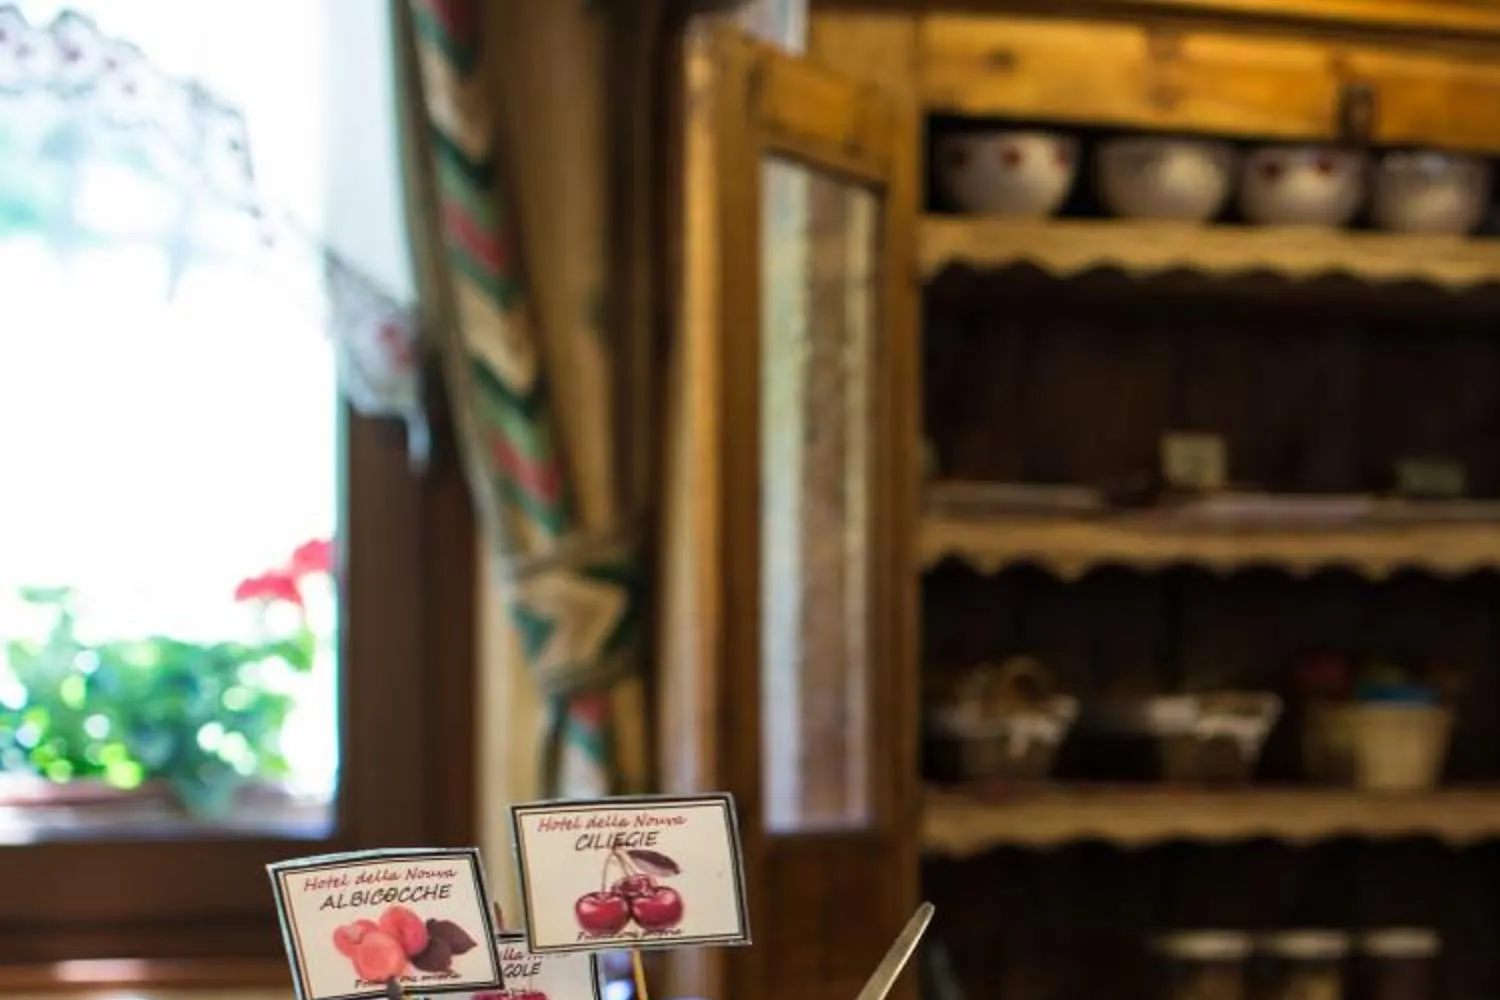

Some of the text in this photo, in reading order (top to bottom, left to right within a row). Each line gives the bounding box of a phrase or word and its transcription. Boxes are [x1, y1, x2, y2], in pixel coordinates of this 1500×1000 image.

[537, 816, 582, 832] Hotel
[585, 813, 630, 829] della
[574, 830, 660, 851] CILIEGIE
[303, 873, 349, 892] Hotel
[355, 867, 399, 885] della
[319, 882, 453, 911] ALBICOCCHE
[502, 961, 542, 978] GOLE
